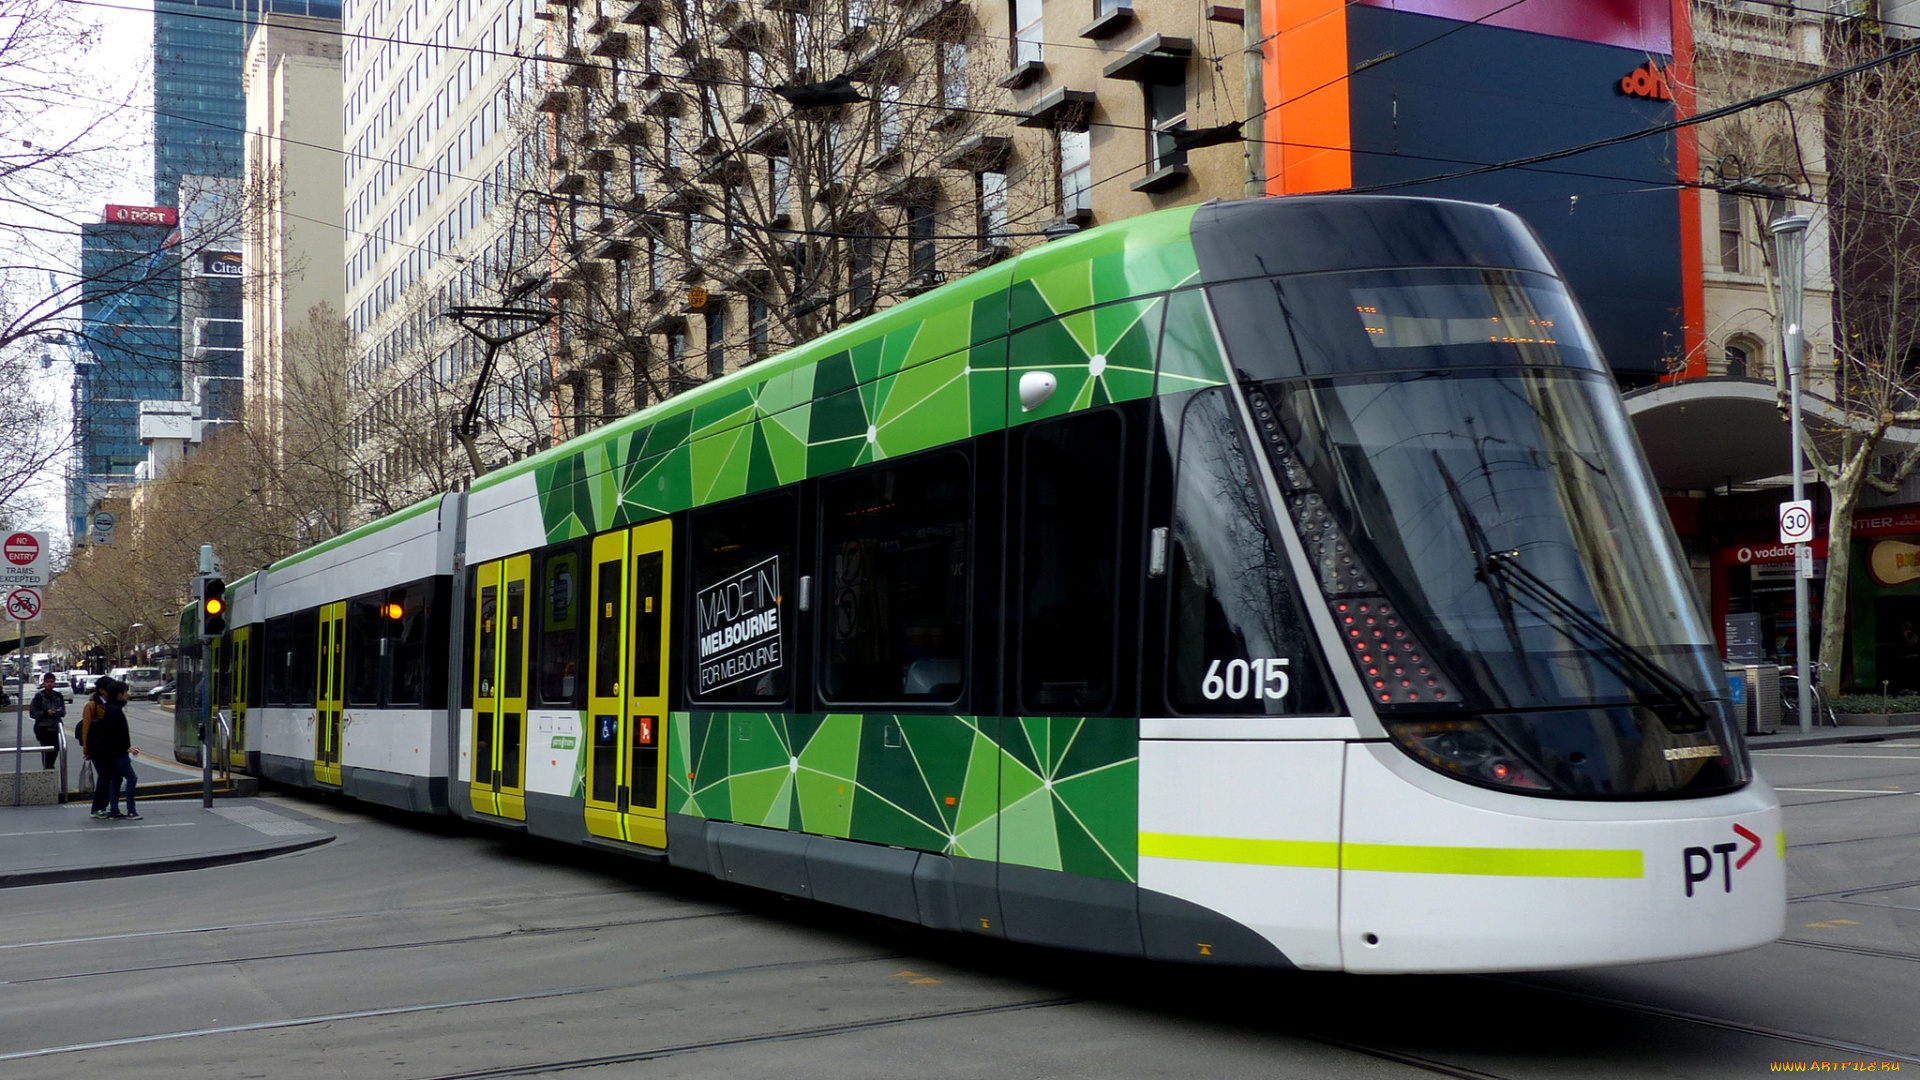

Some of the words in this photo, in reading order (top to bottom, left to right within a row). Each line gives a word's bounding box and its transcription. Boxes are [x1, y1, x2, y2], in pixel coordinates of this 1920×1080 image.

[131, 211, 166, 222] POST
[1786, 514, 1806, 529] 30
[16, 537, 28, 545] NO
[9, 553, 35, 561] ENTRY
[1755, 545, 1796, 558] vodafo
[0, 575, 41, 583] EXCEPTED
[699, 574, 754, 634] MADE
[757, 563, 777, 609] IN
[701, 607, 778, 658] MELBOURNE
[702, 664, 720, 686] FOR
[720, 642, 779, 680] MELBOURNE
[1202, 658, 1289, 700] 6015
